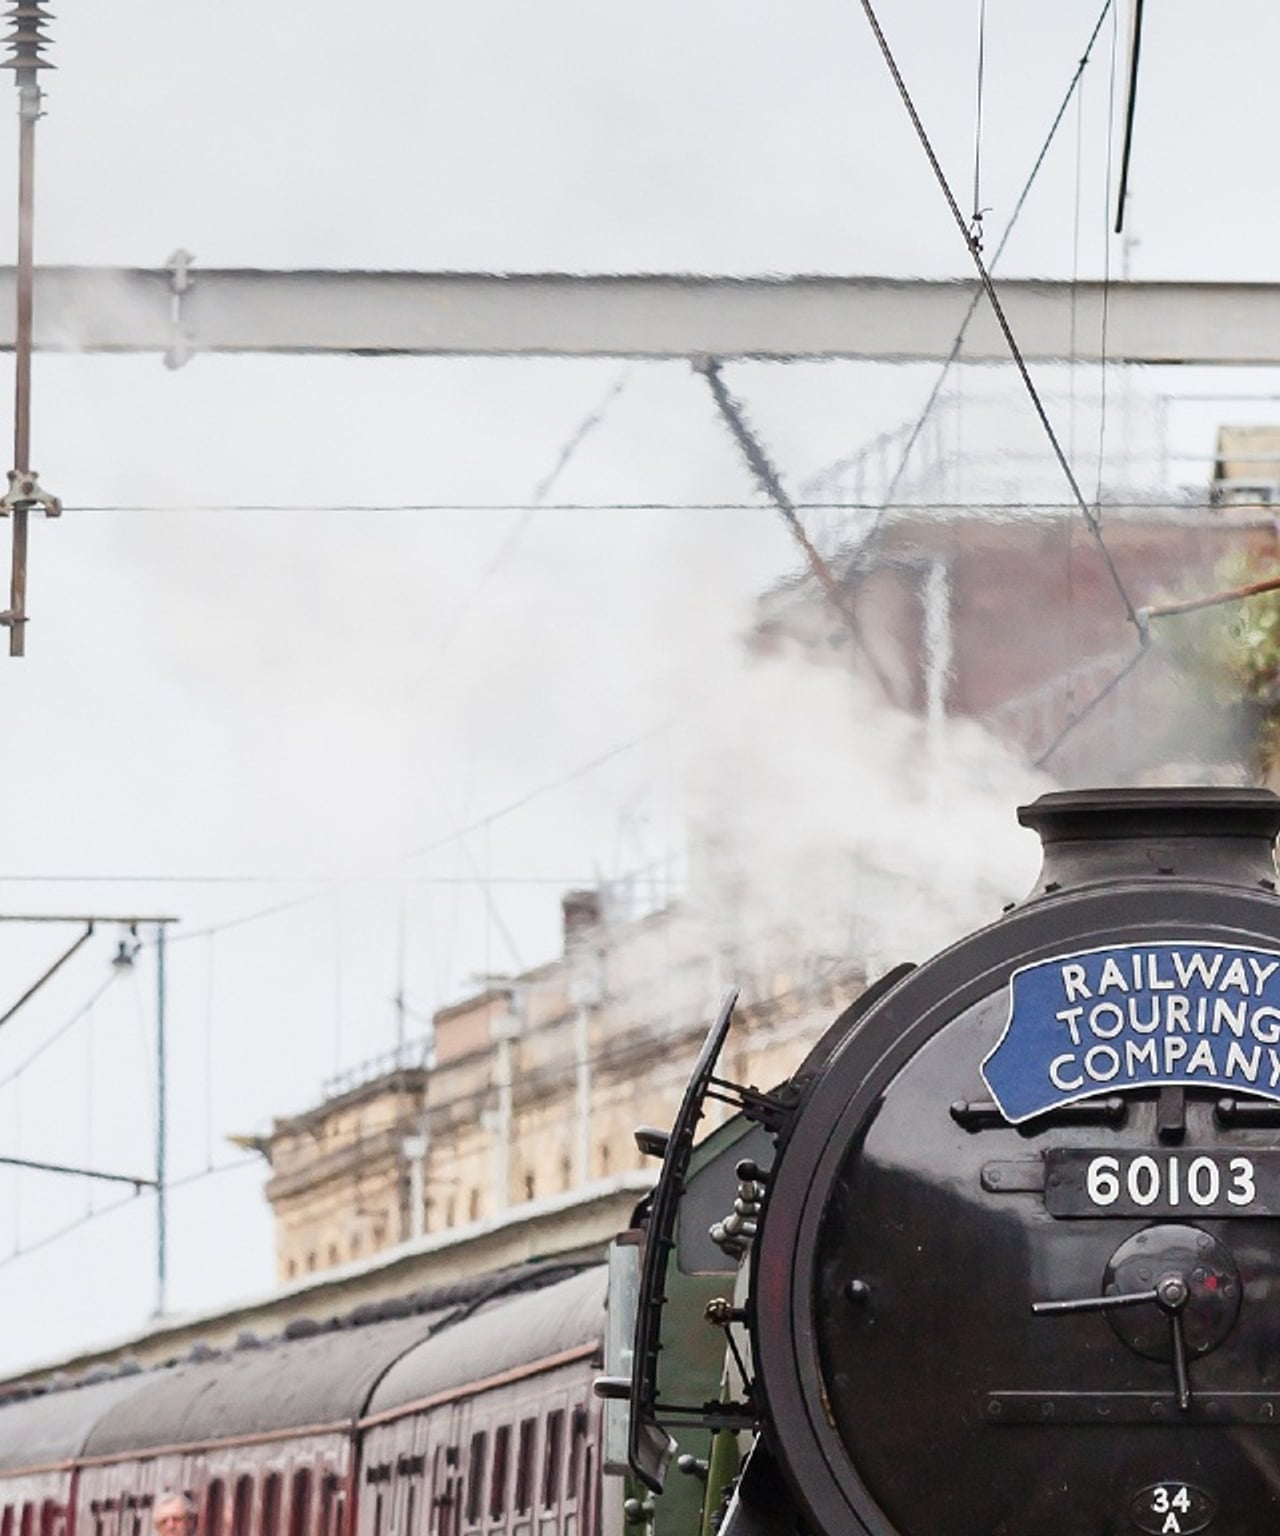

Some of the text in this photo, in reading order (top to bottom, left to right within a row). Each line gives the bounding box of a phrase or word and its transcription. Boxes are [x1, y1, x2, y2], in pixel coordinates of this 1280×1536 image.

[1061, 952, 1280, 1002] RAILWAY
[1086, 1155, 1256, 1206] 60103
[1151, 1486, 1191, 1513] 34
[1161, 1511, 1180, 1534] A
